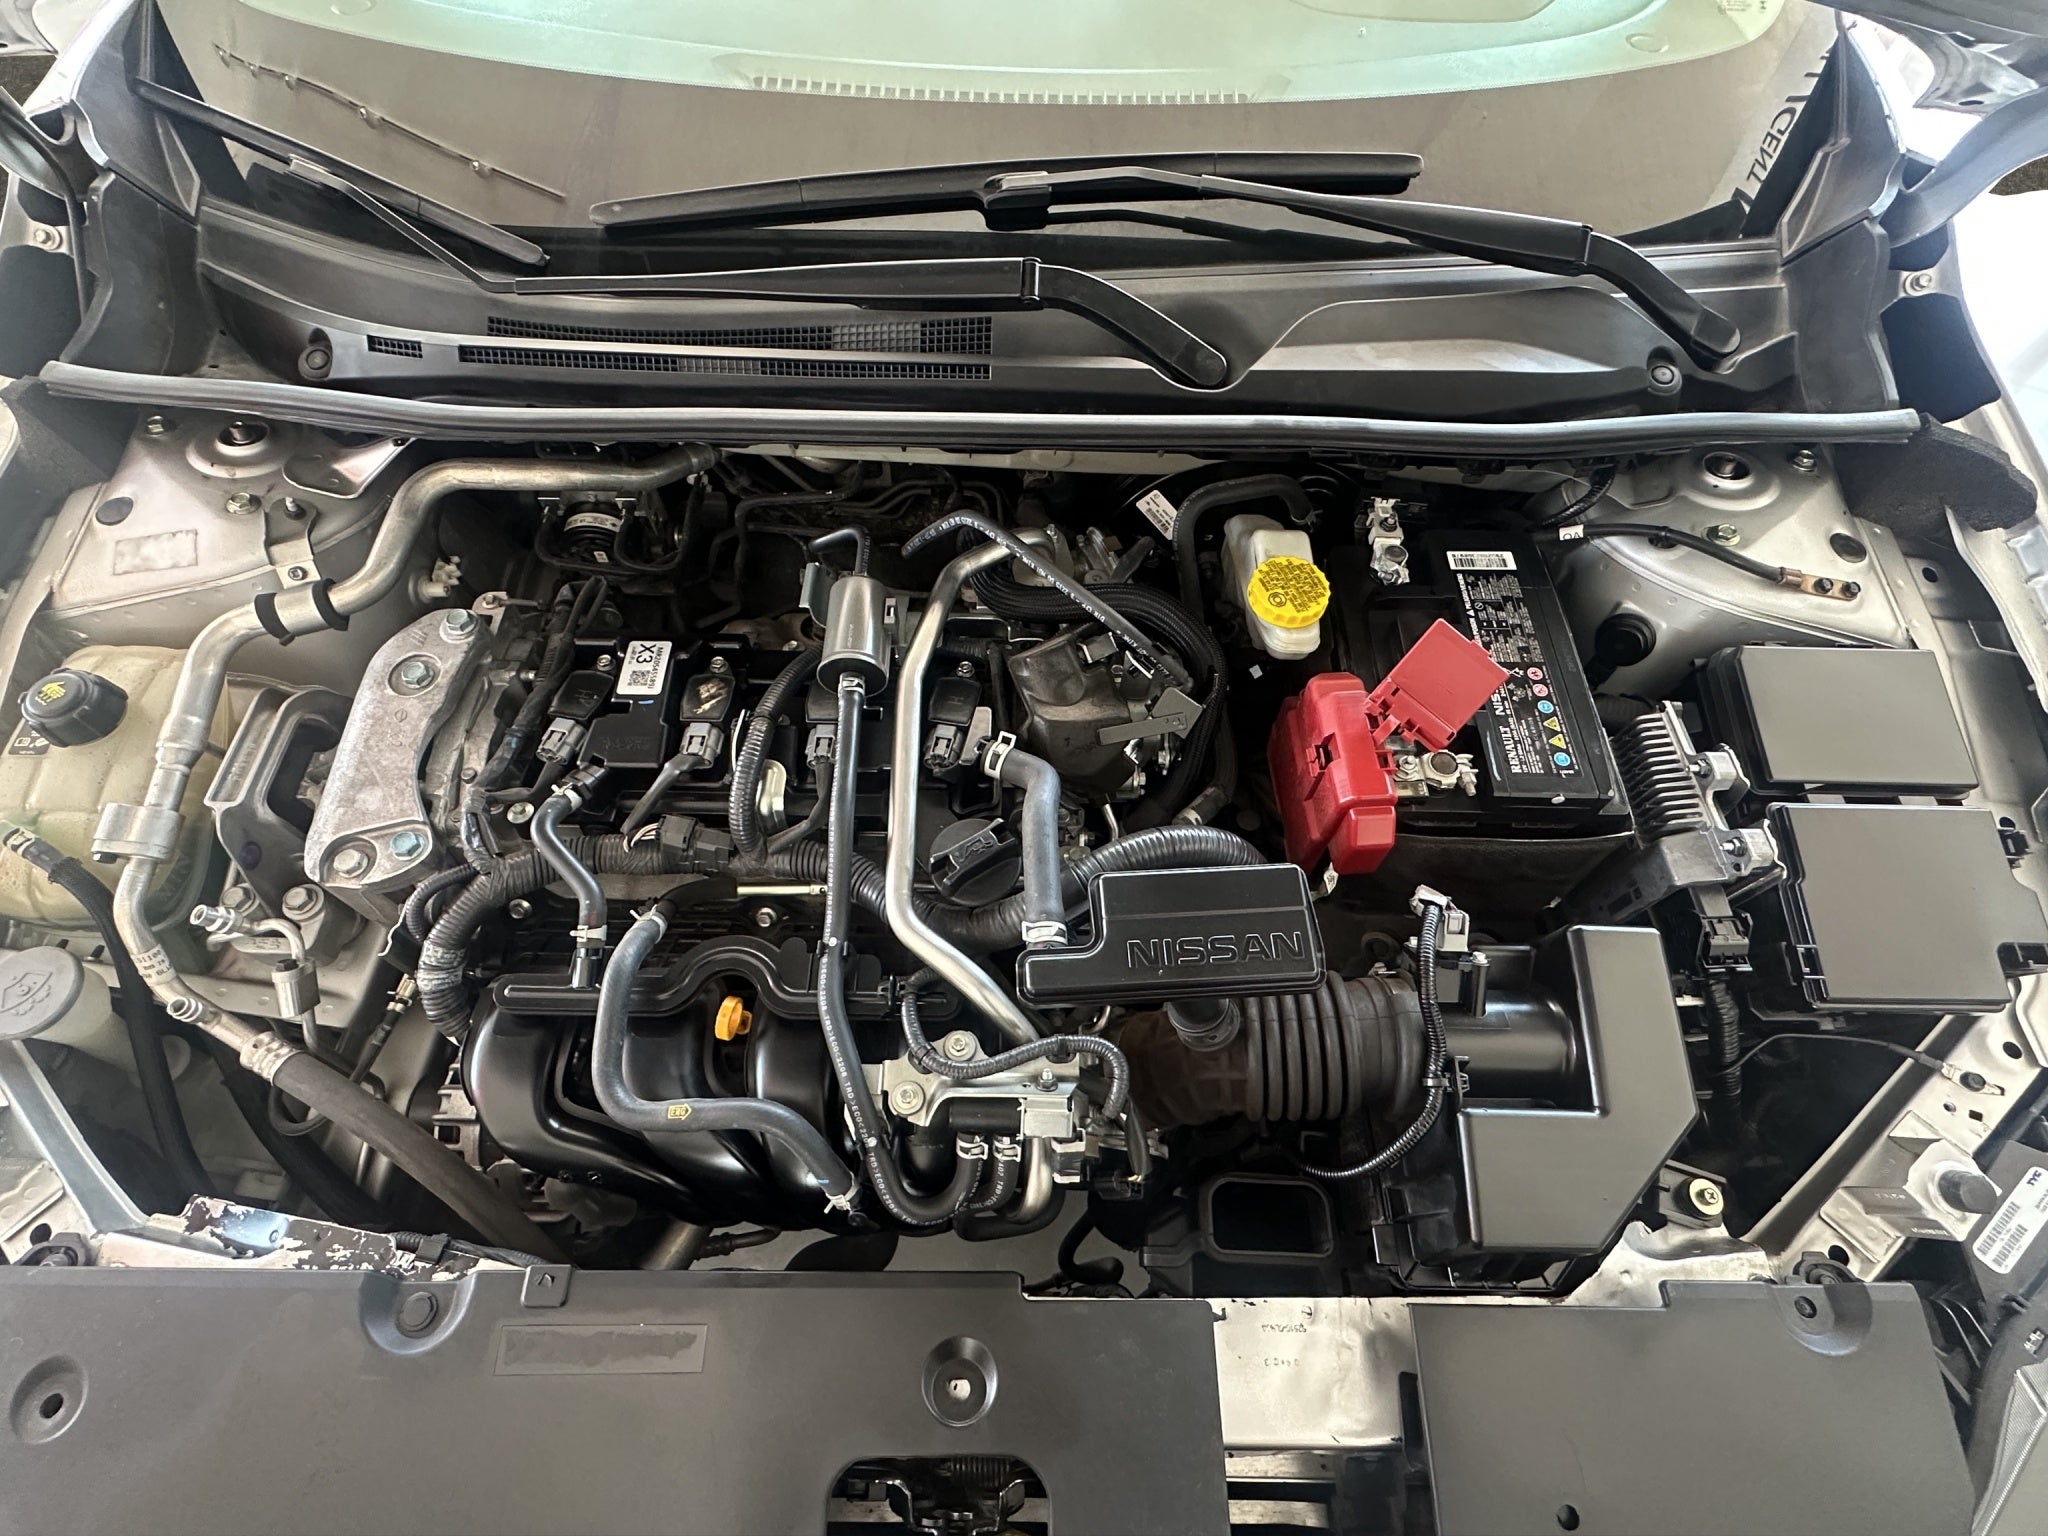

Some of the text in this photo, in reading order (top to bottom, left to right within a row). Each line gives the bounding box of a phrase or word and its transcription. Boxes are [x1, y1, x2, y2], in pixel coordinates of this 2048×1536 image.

[636, 643, 656, 664] X3
[1499, 725, 1522, 773] RENAULT
[1126, 931, 1306, 968] NISSAN
[2026, 1169, 2042, 1186] TYC
